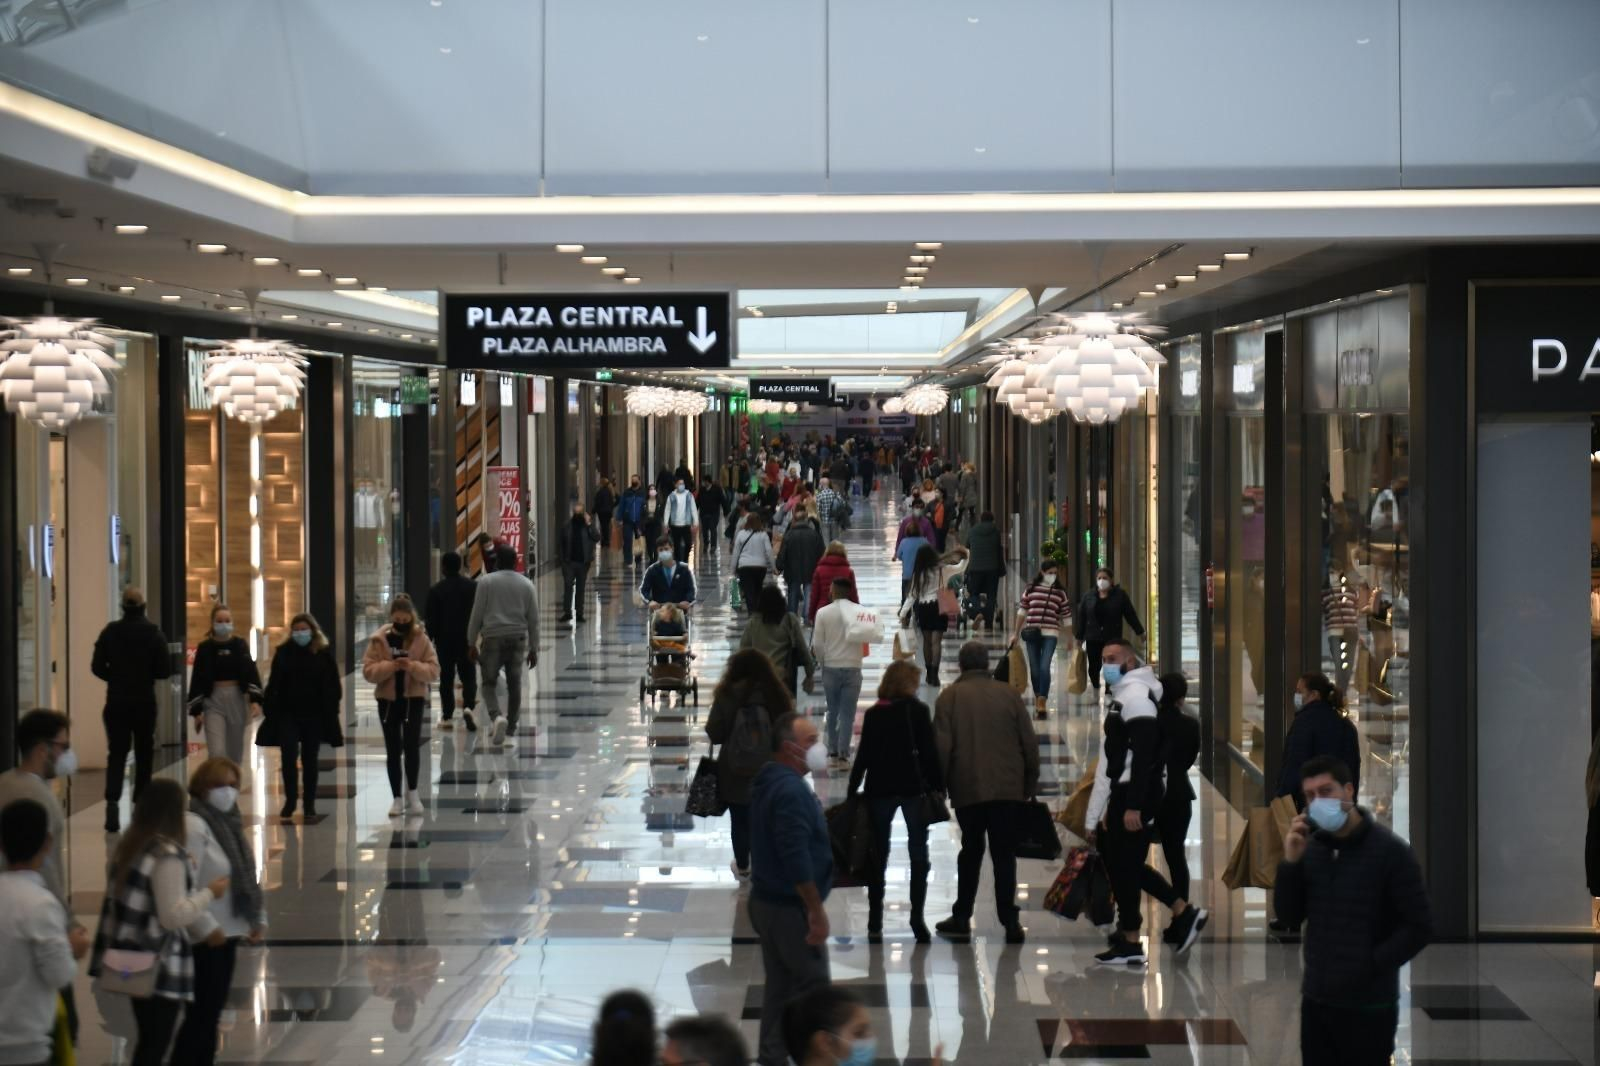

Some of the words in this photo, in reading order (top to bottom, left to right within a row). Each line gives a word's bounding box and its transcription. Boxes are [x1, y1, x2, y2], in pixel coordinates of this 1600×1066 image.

[467, 306, 553, 327] PLAZA
[560, 305, 684, 327] CENTRAL
[482, 336, 550, 353] PLAZA
[551, 336, 668, 353] ALHAMBRA
[500, 521, 520, 533] AJAS
